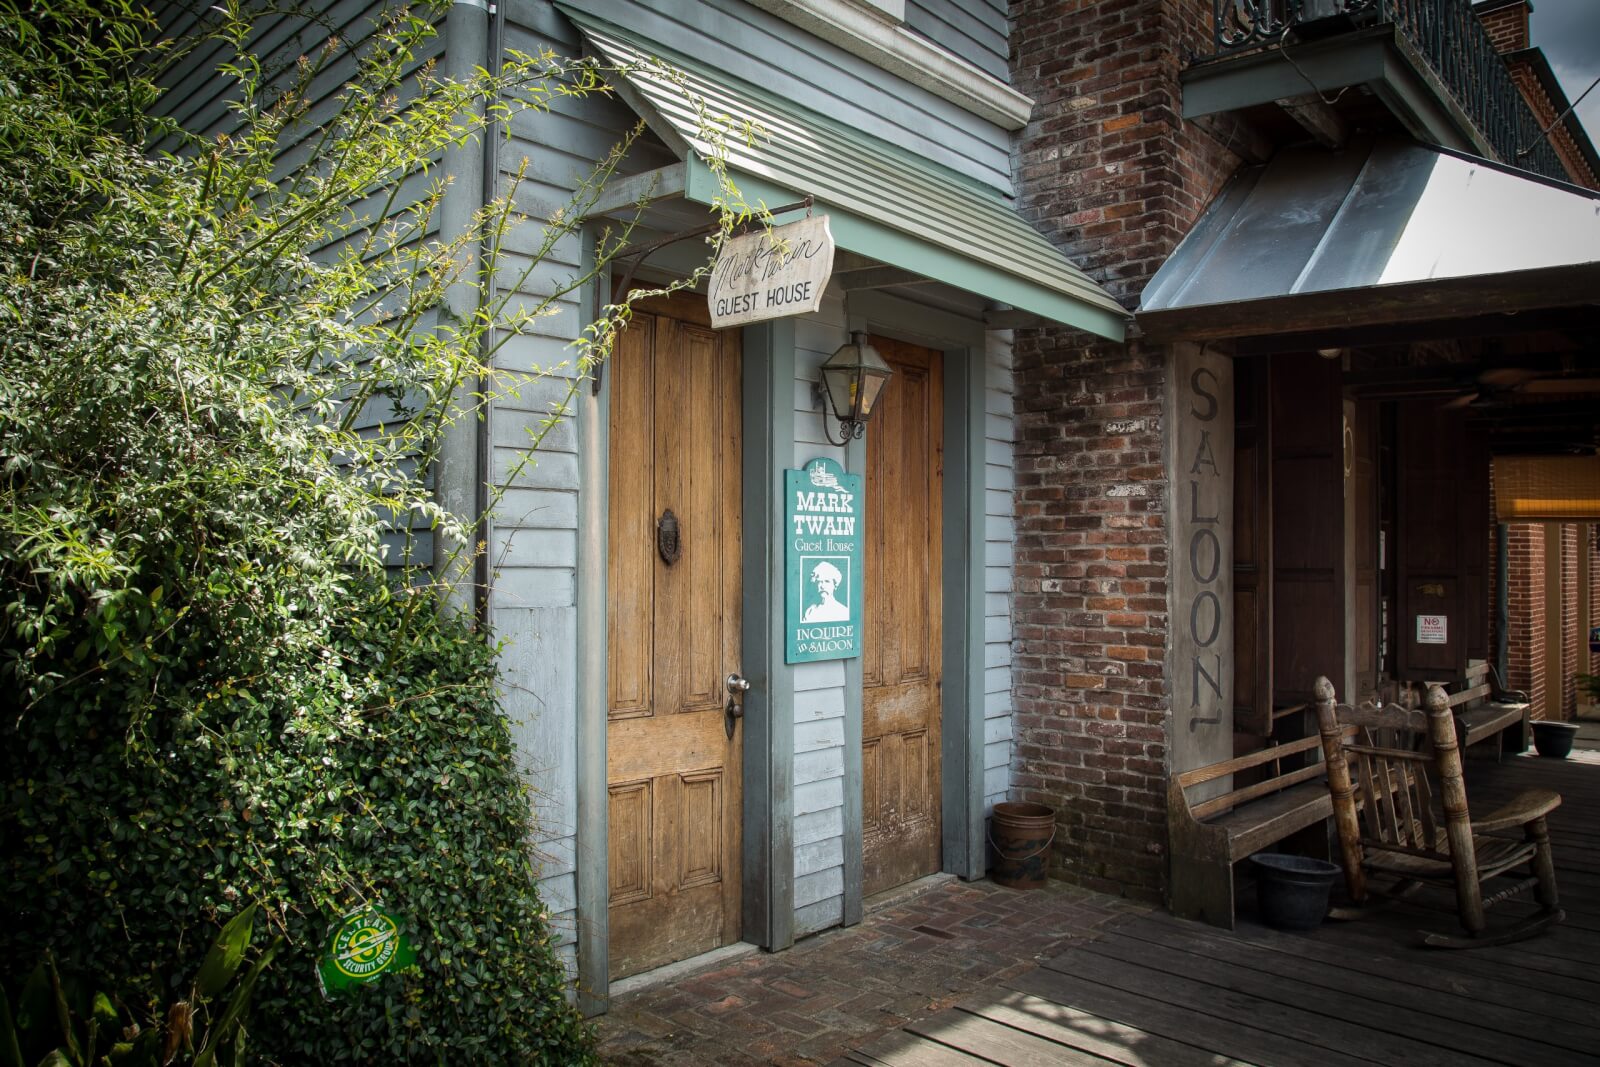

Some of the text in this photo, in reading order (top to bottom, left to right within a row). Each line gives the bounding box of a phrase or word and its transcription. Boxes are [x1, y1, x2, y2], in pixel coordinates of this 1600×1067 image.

[714, 237, 824, 300] Mark Twain
[716, 281, 812, 317] GUEST HOUSE
[796, 491, 854, 513] MARK
[793, 514, 856, 536] TWAIN
[794, 538, 855, 552] Guest House
[1189, 367, 1223, 708] SALOON
[797, 625, 854, 640] INQUIRE
[797, 639, 853, 653] in SALOON
[342, 940, 394, 973] SECURITY GROU
